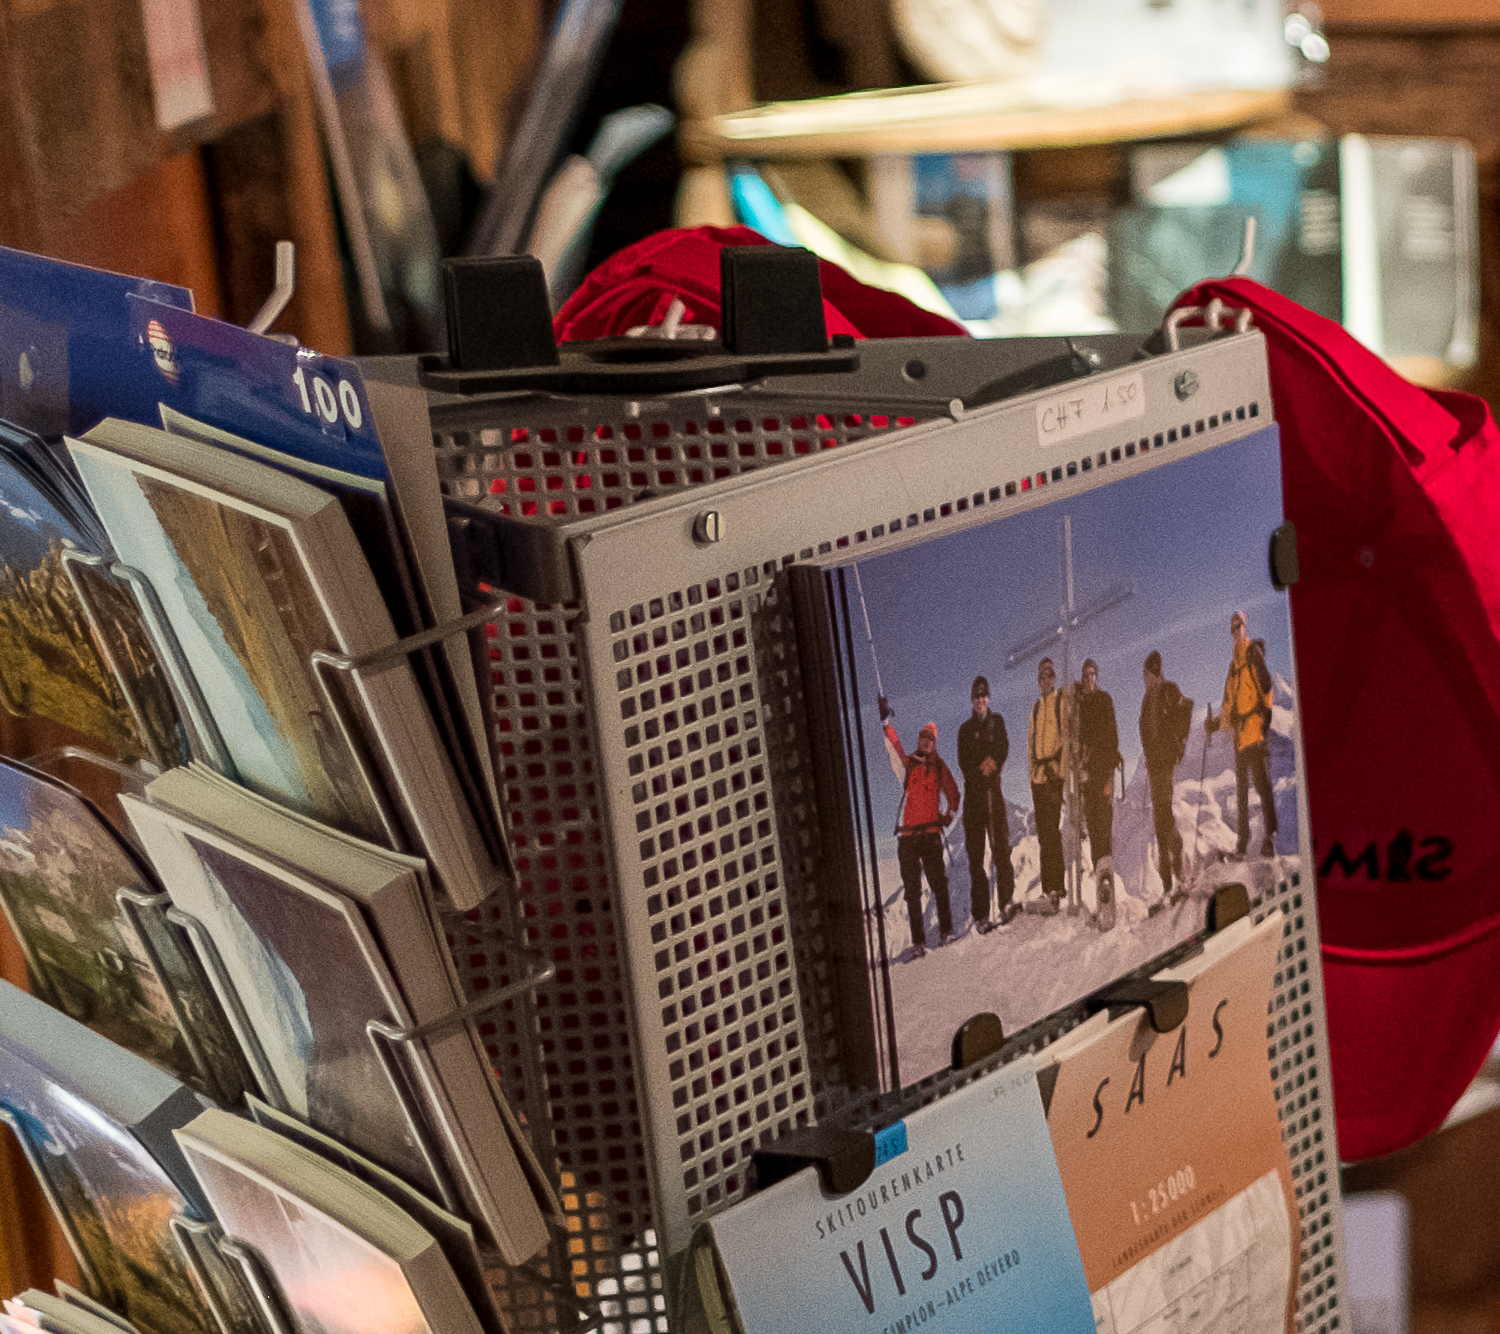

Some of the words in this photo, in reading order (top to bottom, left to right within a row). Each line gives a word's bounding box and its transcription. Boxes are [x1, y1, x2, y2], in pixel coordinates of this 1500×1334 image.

[1085, 997, 1228, 1140] SAAS
[815, 1142, 966, 1240] SKITOURENKARTE
[838, 1189, 965, 1315] VISP
